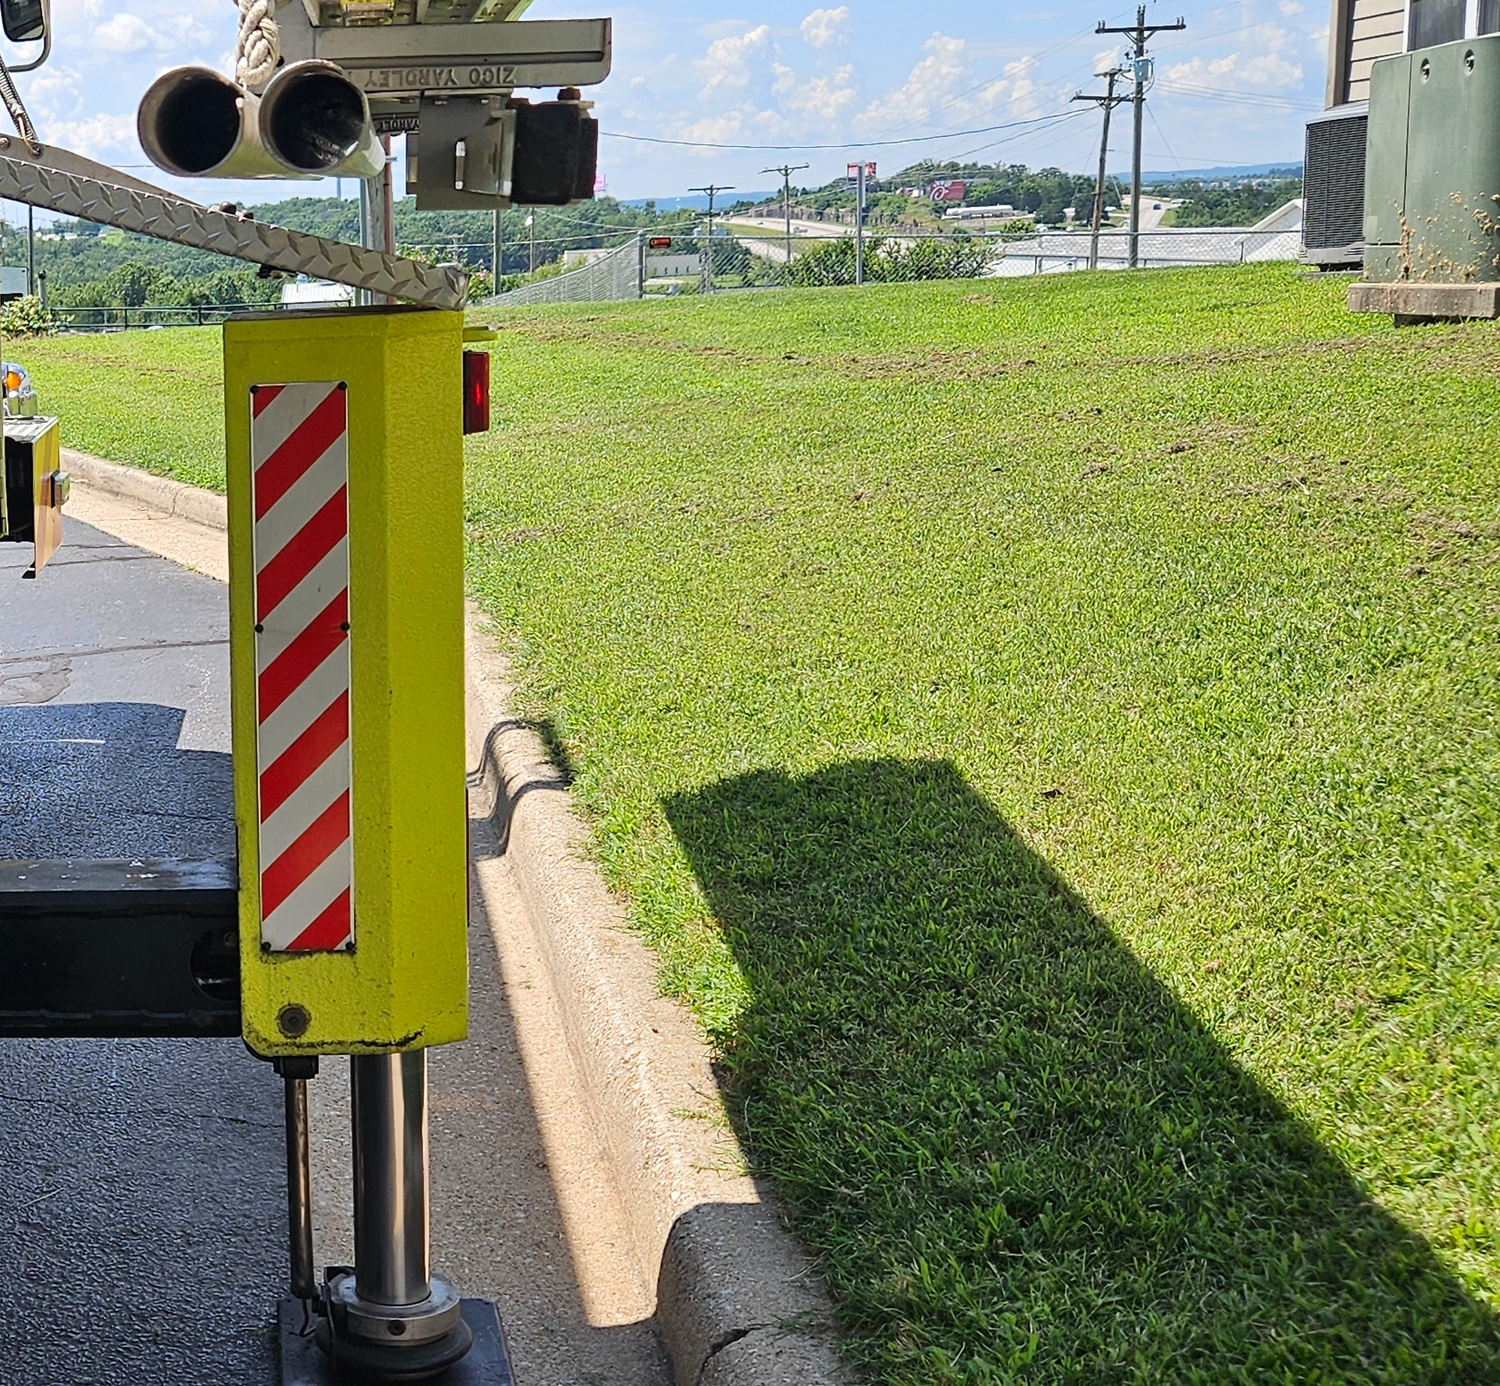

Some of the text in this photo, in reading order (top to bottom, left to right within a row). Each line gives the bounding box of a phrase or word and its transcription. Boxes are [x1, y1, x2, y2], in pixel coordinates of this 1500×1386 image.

[364, 67, 459, 87] YARDLEY
[469, 66, 517, 85] ZICO
[379, 118, 420, 131] YARDL
